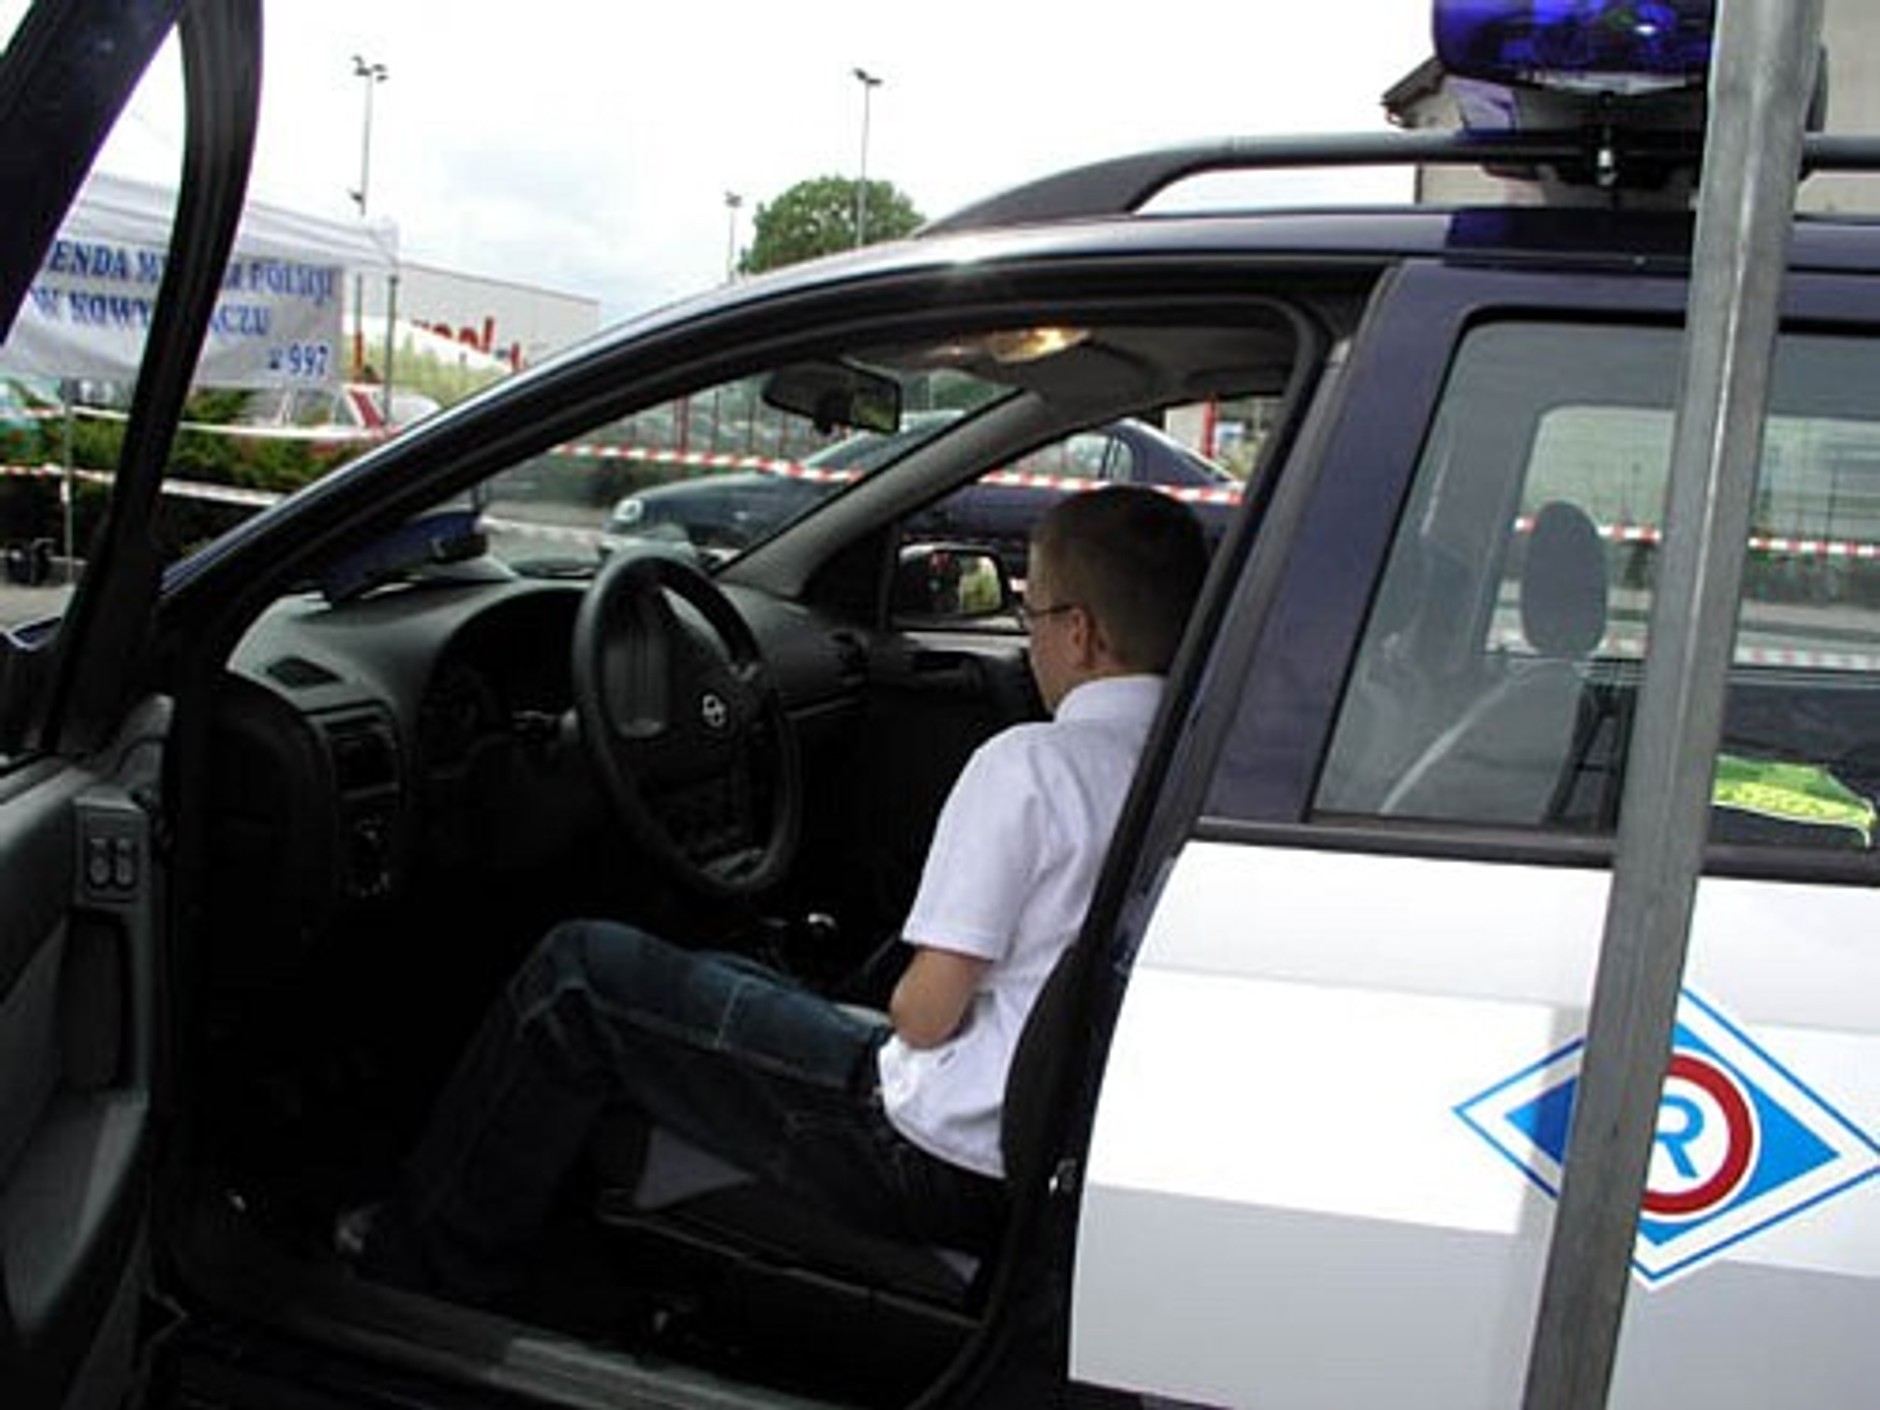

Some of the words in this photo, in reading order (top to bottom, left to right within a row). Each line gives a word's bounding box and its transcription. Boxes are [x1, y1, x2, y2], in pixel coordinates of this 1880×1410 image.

[51, 241, 129, 282] ENDA
[69, 292, 152, 328] NOWY
[213, 304, 269, 336] CZU
[290, 342, 328, 376] 997
[1655, 1093, 1705, 1179] R
